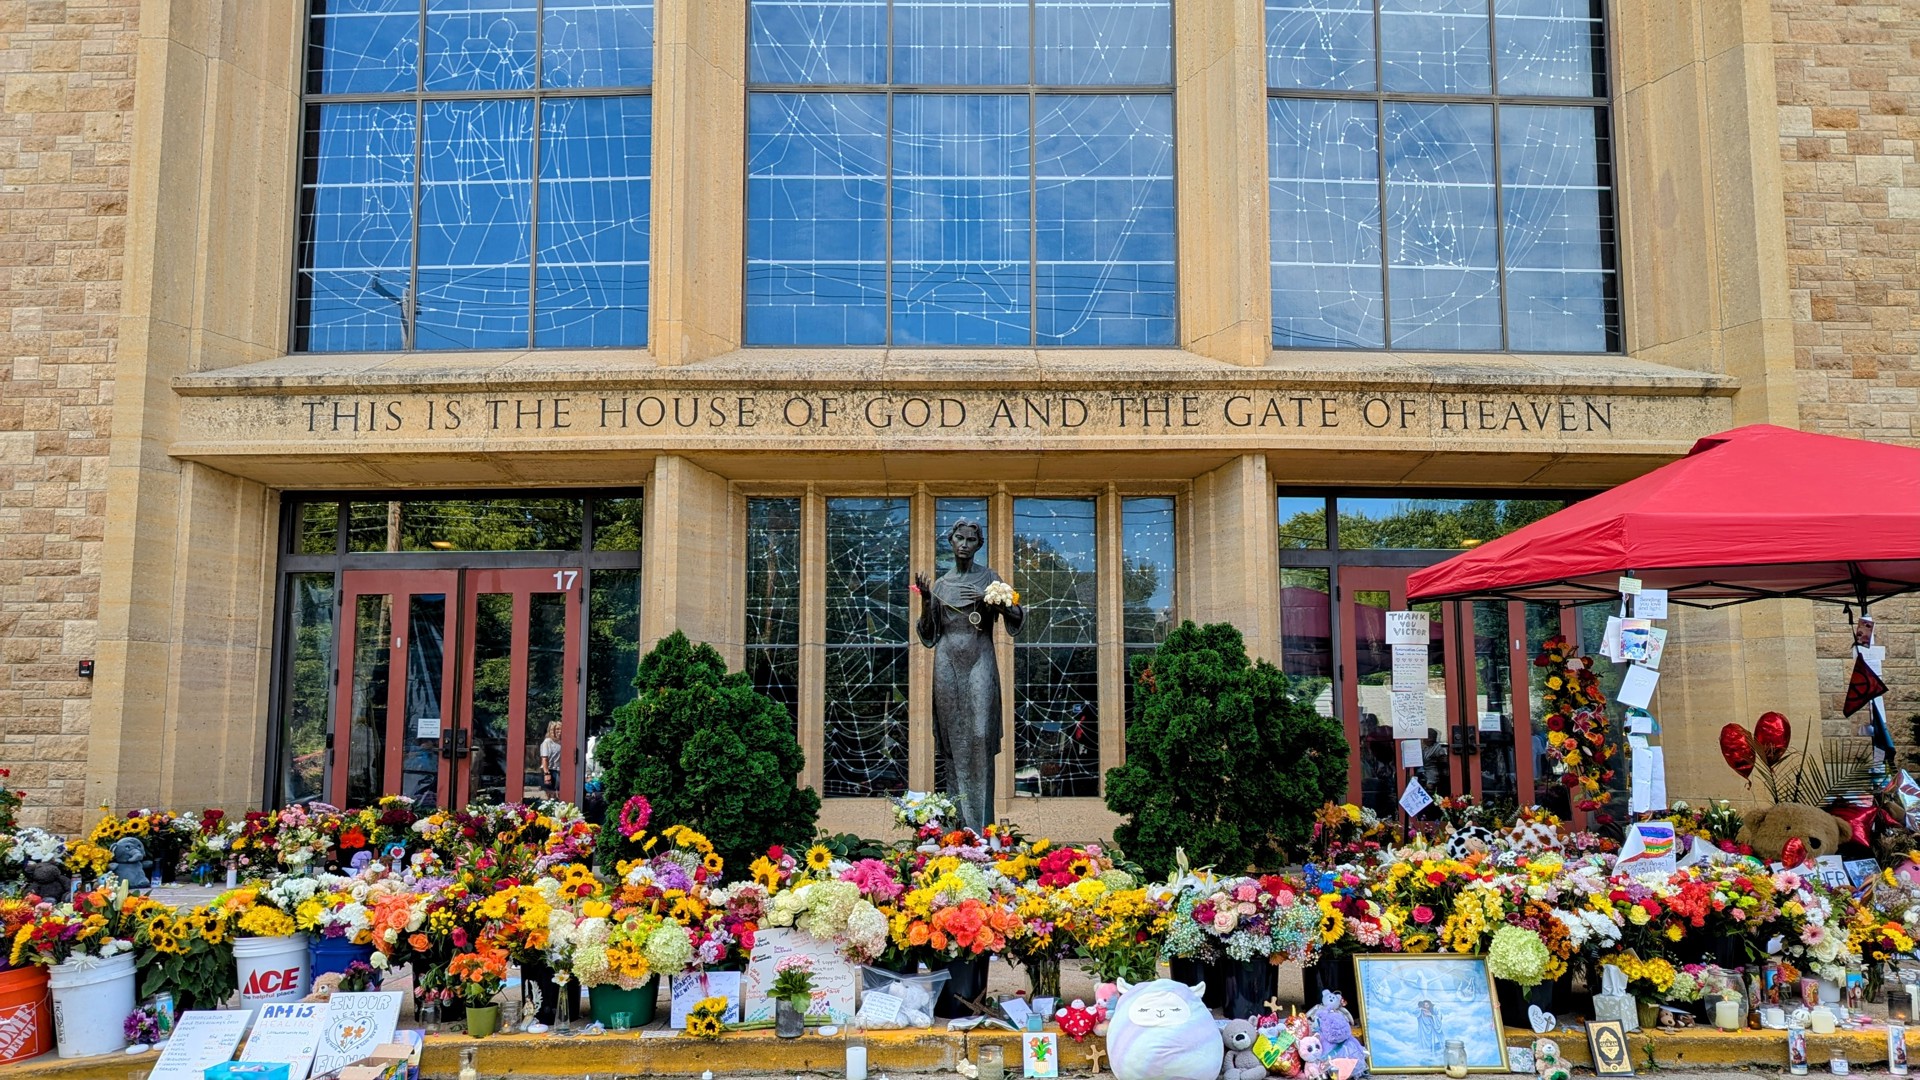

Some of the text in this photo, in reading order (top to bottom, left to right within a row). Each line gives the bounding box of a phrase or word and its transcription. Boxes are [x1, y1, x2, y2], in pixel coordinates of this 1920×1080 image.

[302, 395, 1612, 432] THIS IS THE HOUSE OF GOD AND THE GATE OF HEAVEN
[553, 570, 578, 590] 17
[1389, 612, 1426, 621] THANK
[1393, 628, 1427, 636] VICTOR
[243, 966, 300, 995] ACE
[330, 994, 392, 1011] IN OUR
[259, 1020, 314, 1028] HEALING
[332, 1010, 376, 1023] HEARTS
[0, 1004, 36, 1055] OME
[1, 1021, 36, 1059] DEPOT
